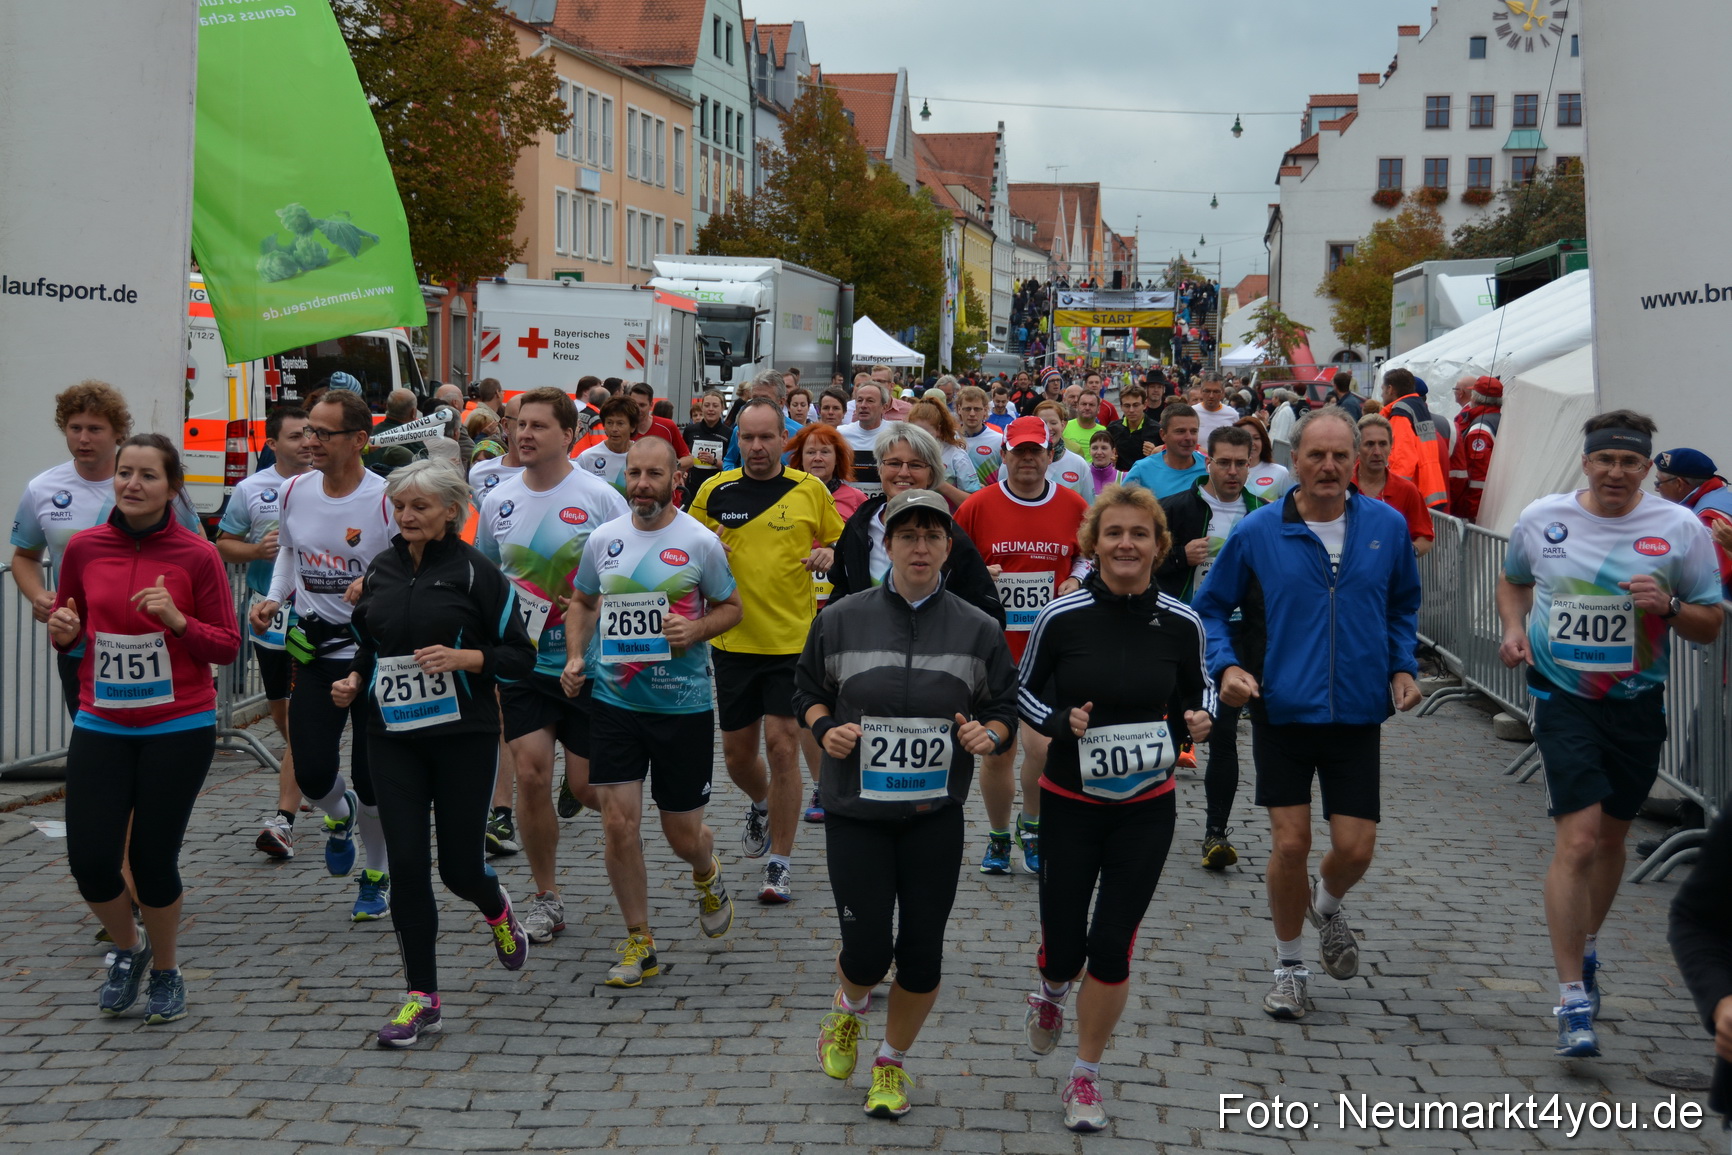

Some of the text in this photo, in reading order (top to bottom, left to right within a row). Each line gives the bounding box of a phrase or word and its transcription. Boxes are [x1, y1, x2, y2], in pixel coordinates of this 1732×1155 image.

[0, 276, 138, 304] laufsport.de
[1092, 314, 1133, 324] START
[554, 329, 610, 340] Bayerisches
[553, 341, 580, 349] Rotes
[553, 352, 579, 361] Kreuz
[856, 352, 893, 363] Laufsport
[563, 511, 585, 520] Hervis
[721, 512, 748, 520] Robert
[992, 541, 1059, 554] NEUMARKT
[1638, 540, 1667, 551] Hervis
[663, 551, 686, 563] Hervis
[1000, 586, 1050, 608] 2653
[1553, 600, 1620, 611] PARTL Neumarkt
[607, 609, 662, 636] 2630
[1557, 612, 1627, 642] 2402
[97, 638, 153, 650] PARTL Neumarkt
[617, 642, 650, 653] Markus
[1573, 648, 1605, 661] Erwin
[100, 651, 160, 680] 2151
[651, 666, 670, 677] 16.
[107, 686, 154, 698] Christine
[381, 672, 447, 703] 2513
[393, 704, 440, 721] Christine
[863, 723, 937, 734] PARTL Neumarkt
[1080, 731, 1154, 745] PARTL Neumarkt
[870, 736, 945, 769] 2492
[1090, 742, 1164, 777] 3017
[886, 776, 926, 789] Sabine
